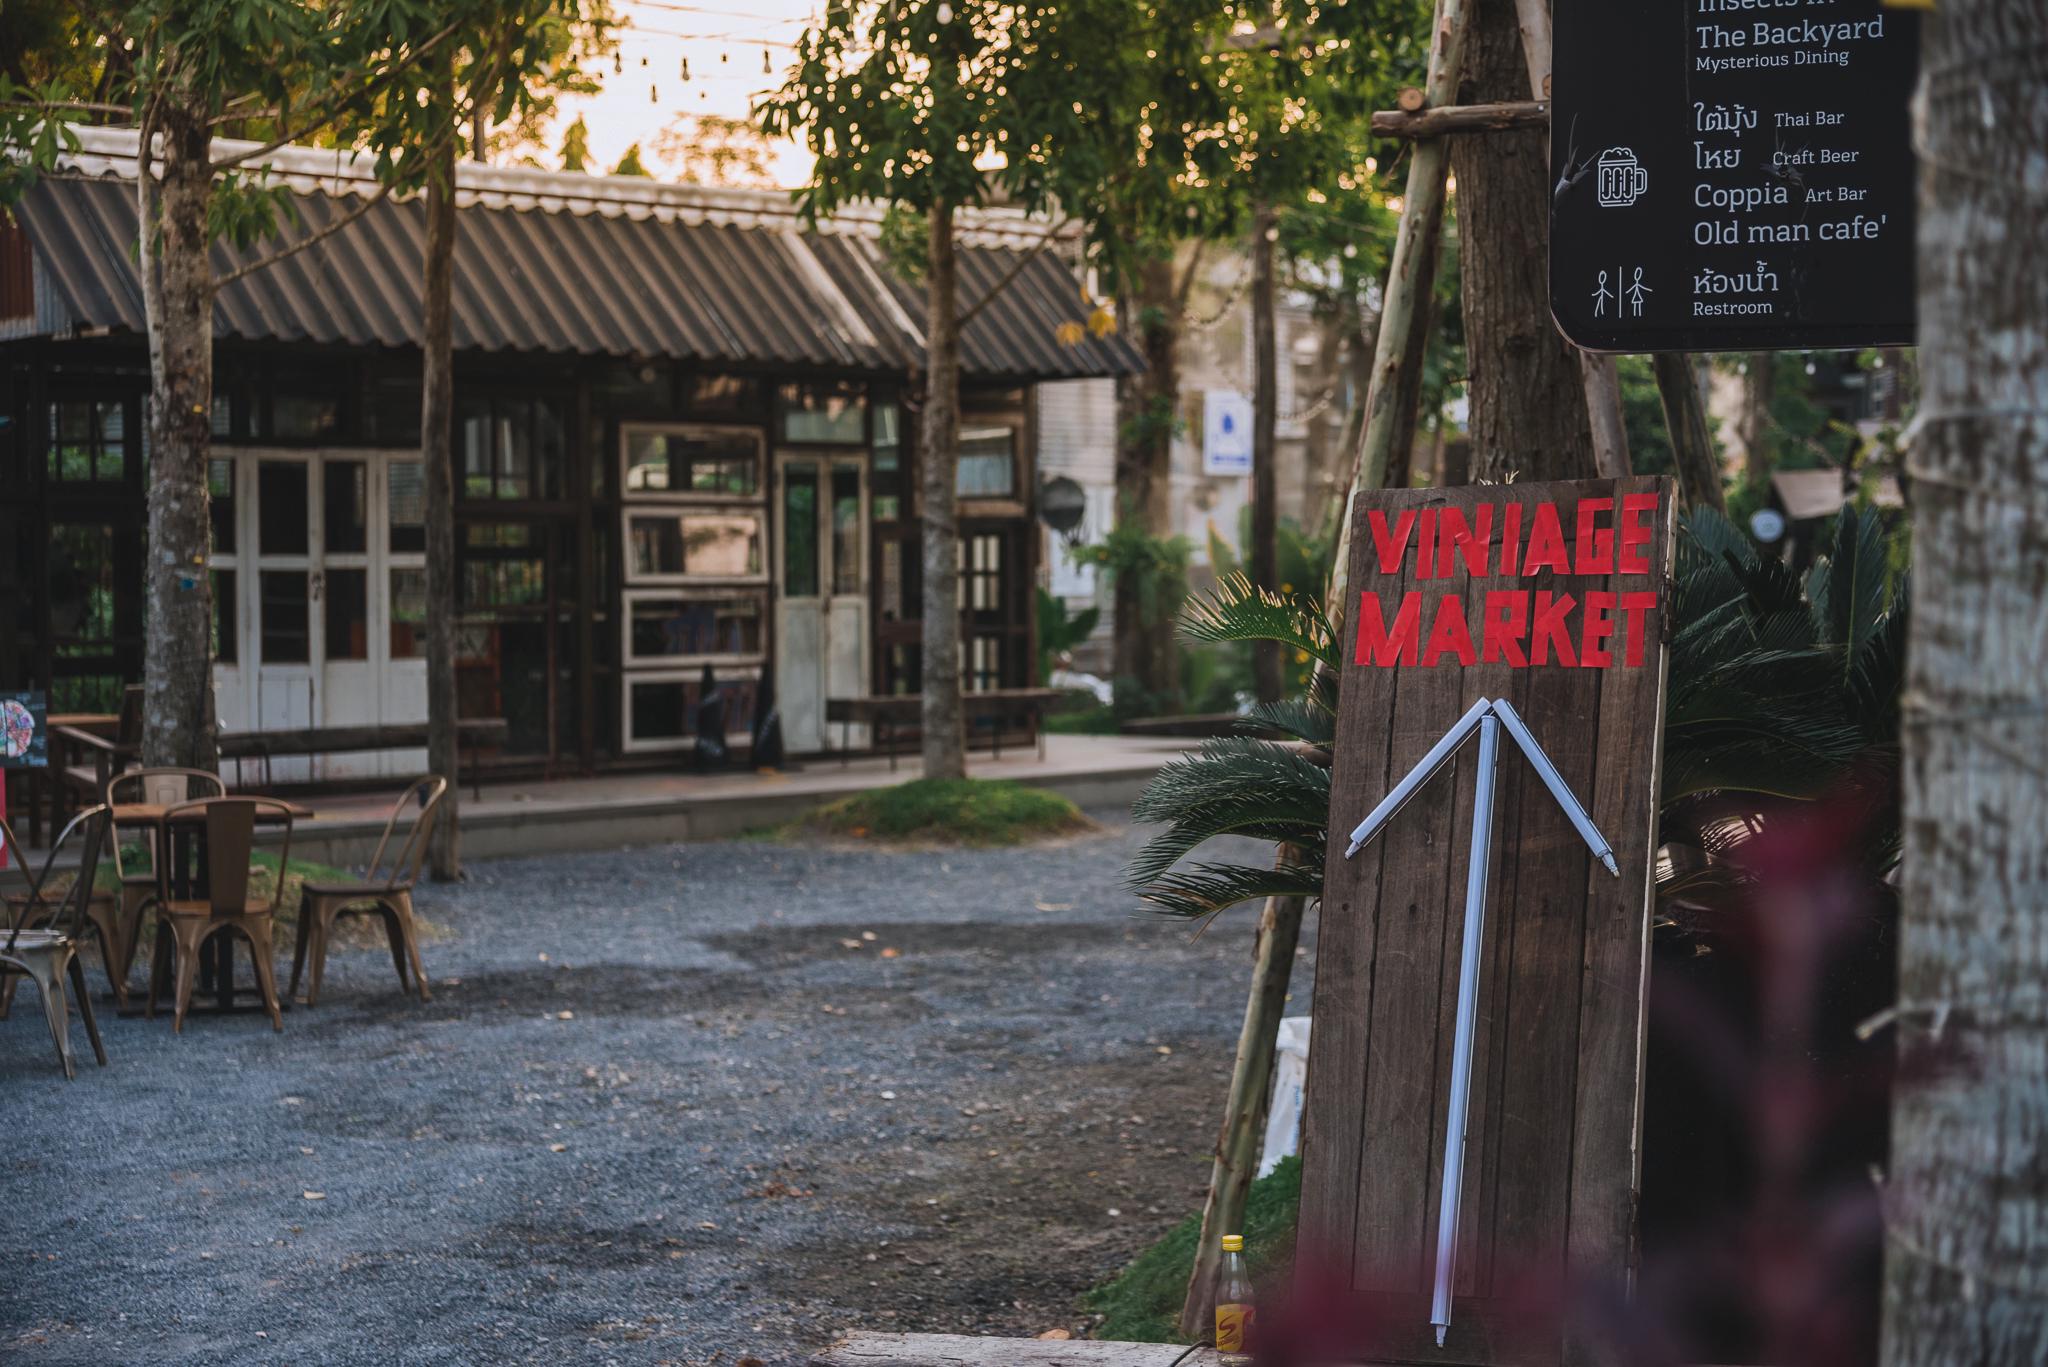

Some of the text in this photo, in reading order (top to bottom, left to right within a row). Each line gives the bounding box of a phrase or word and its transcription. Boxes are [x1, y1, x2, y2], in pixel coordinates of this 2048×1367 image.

[1696, 14, 1885, 49] The Backyard
[1696, 50, 1850, 74] Mysterious Dining
[1774, 112, 1810, 128] Thai
[1815, 110, 1845, 126] Bar
[1772, 149, 1815, 166] Craft
[1820, 149, 1860, 164] Beer
[1694, 181, 1867, 213] Coppia Art Bar
[1694, 219, 1740, 246] Old
[1747, 224, 1811, 244] man
[1693, 260, 1779, 294] ห้องน้ำ
[1693, 301, 1774, 316] Restroom
[1354, 590, 1657, 668] MARKET
